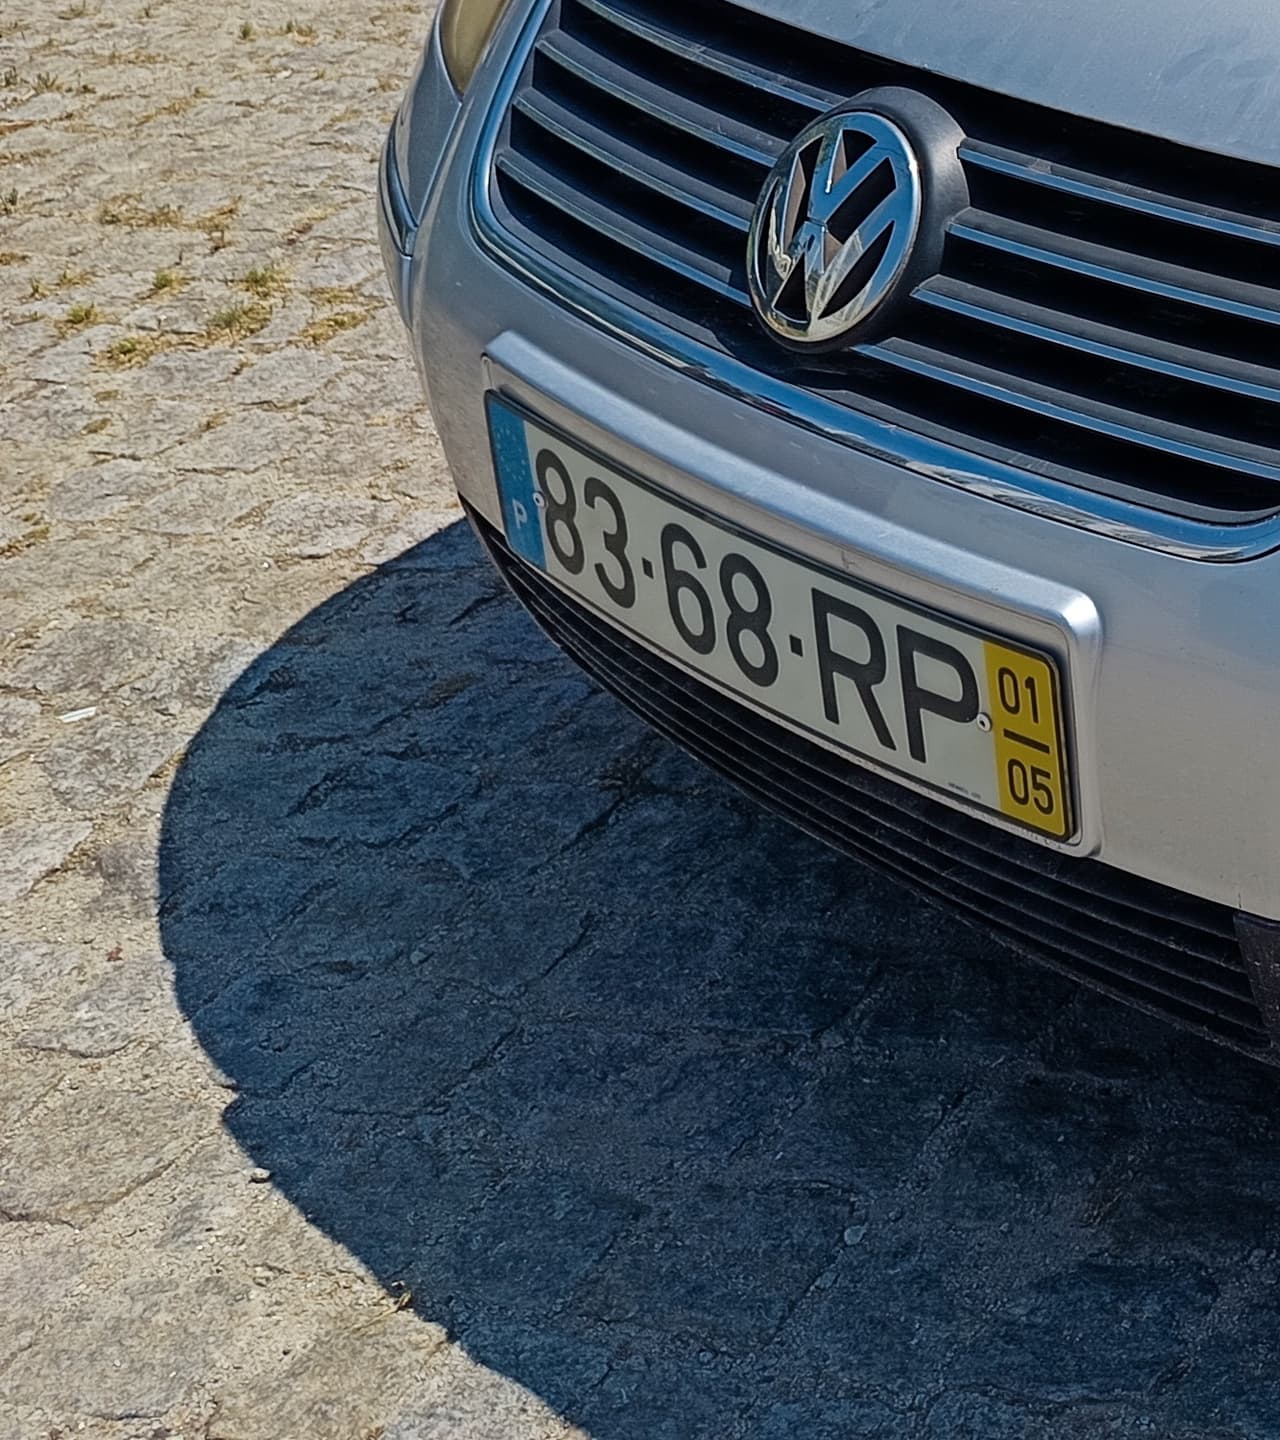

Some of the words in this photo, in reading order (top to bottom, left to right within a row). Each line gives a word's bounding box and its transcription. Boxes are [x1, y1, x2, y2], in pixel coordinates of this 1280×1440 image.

[512, 498, 528, 529] P
[998, 666, 1040, 724] 01
[1007, 758, 1055, 816] 05
